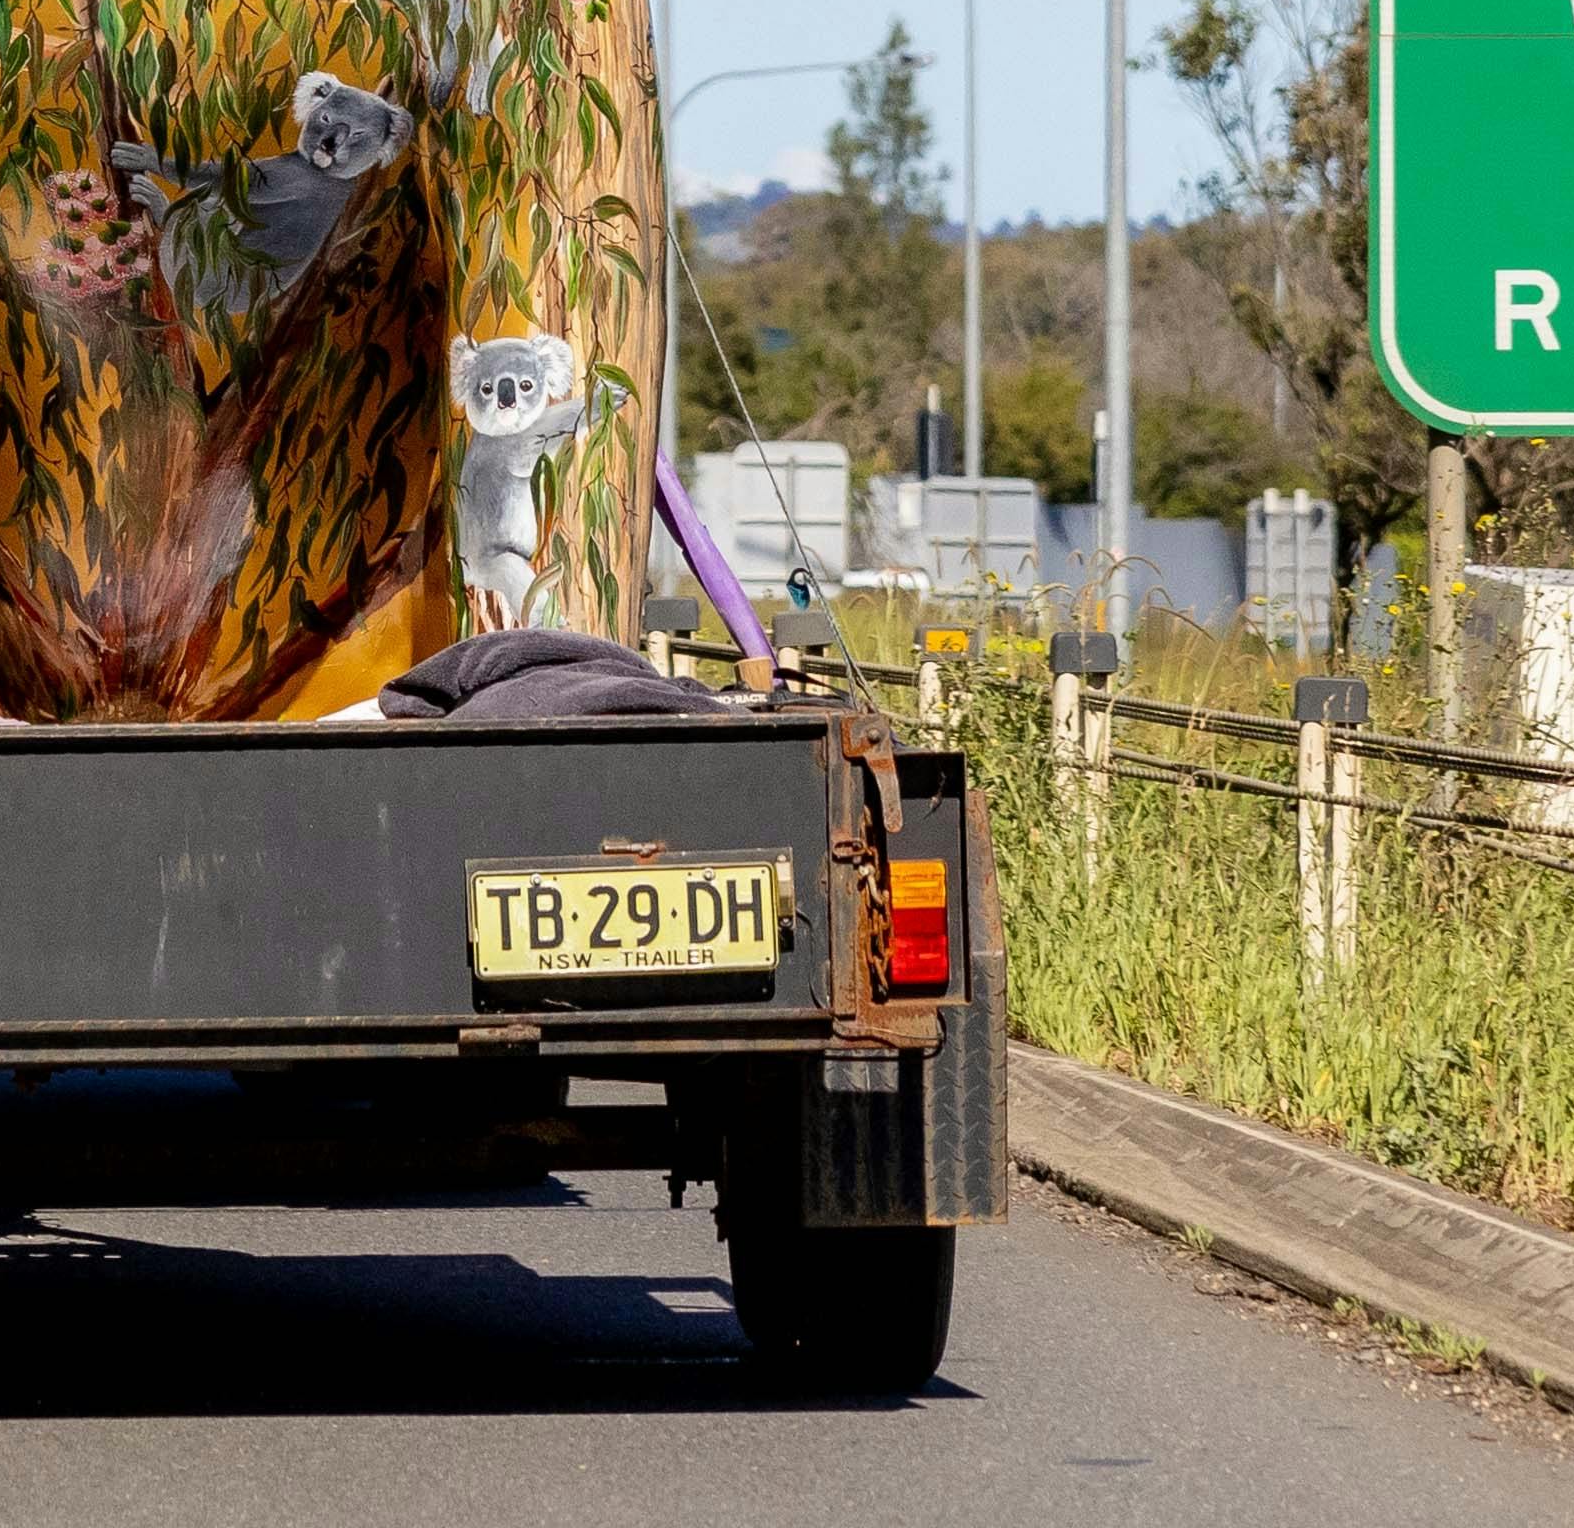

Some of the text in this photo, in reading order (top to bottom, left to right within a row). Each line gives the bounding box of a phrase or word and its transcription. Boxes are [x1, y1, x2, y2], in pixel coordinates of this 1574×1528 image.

[485, 878, 765, 951] TB 29 DH
[538, 952, 593, 970] NSW
[621, 949, 715, 967] TRAILER
